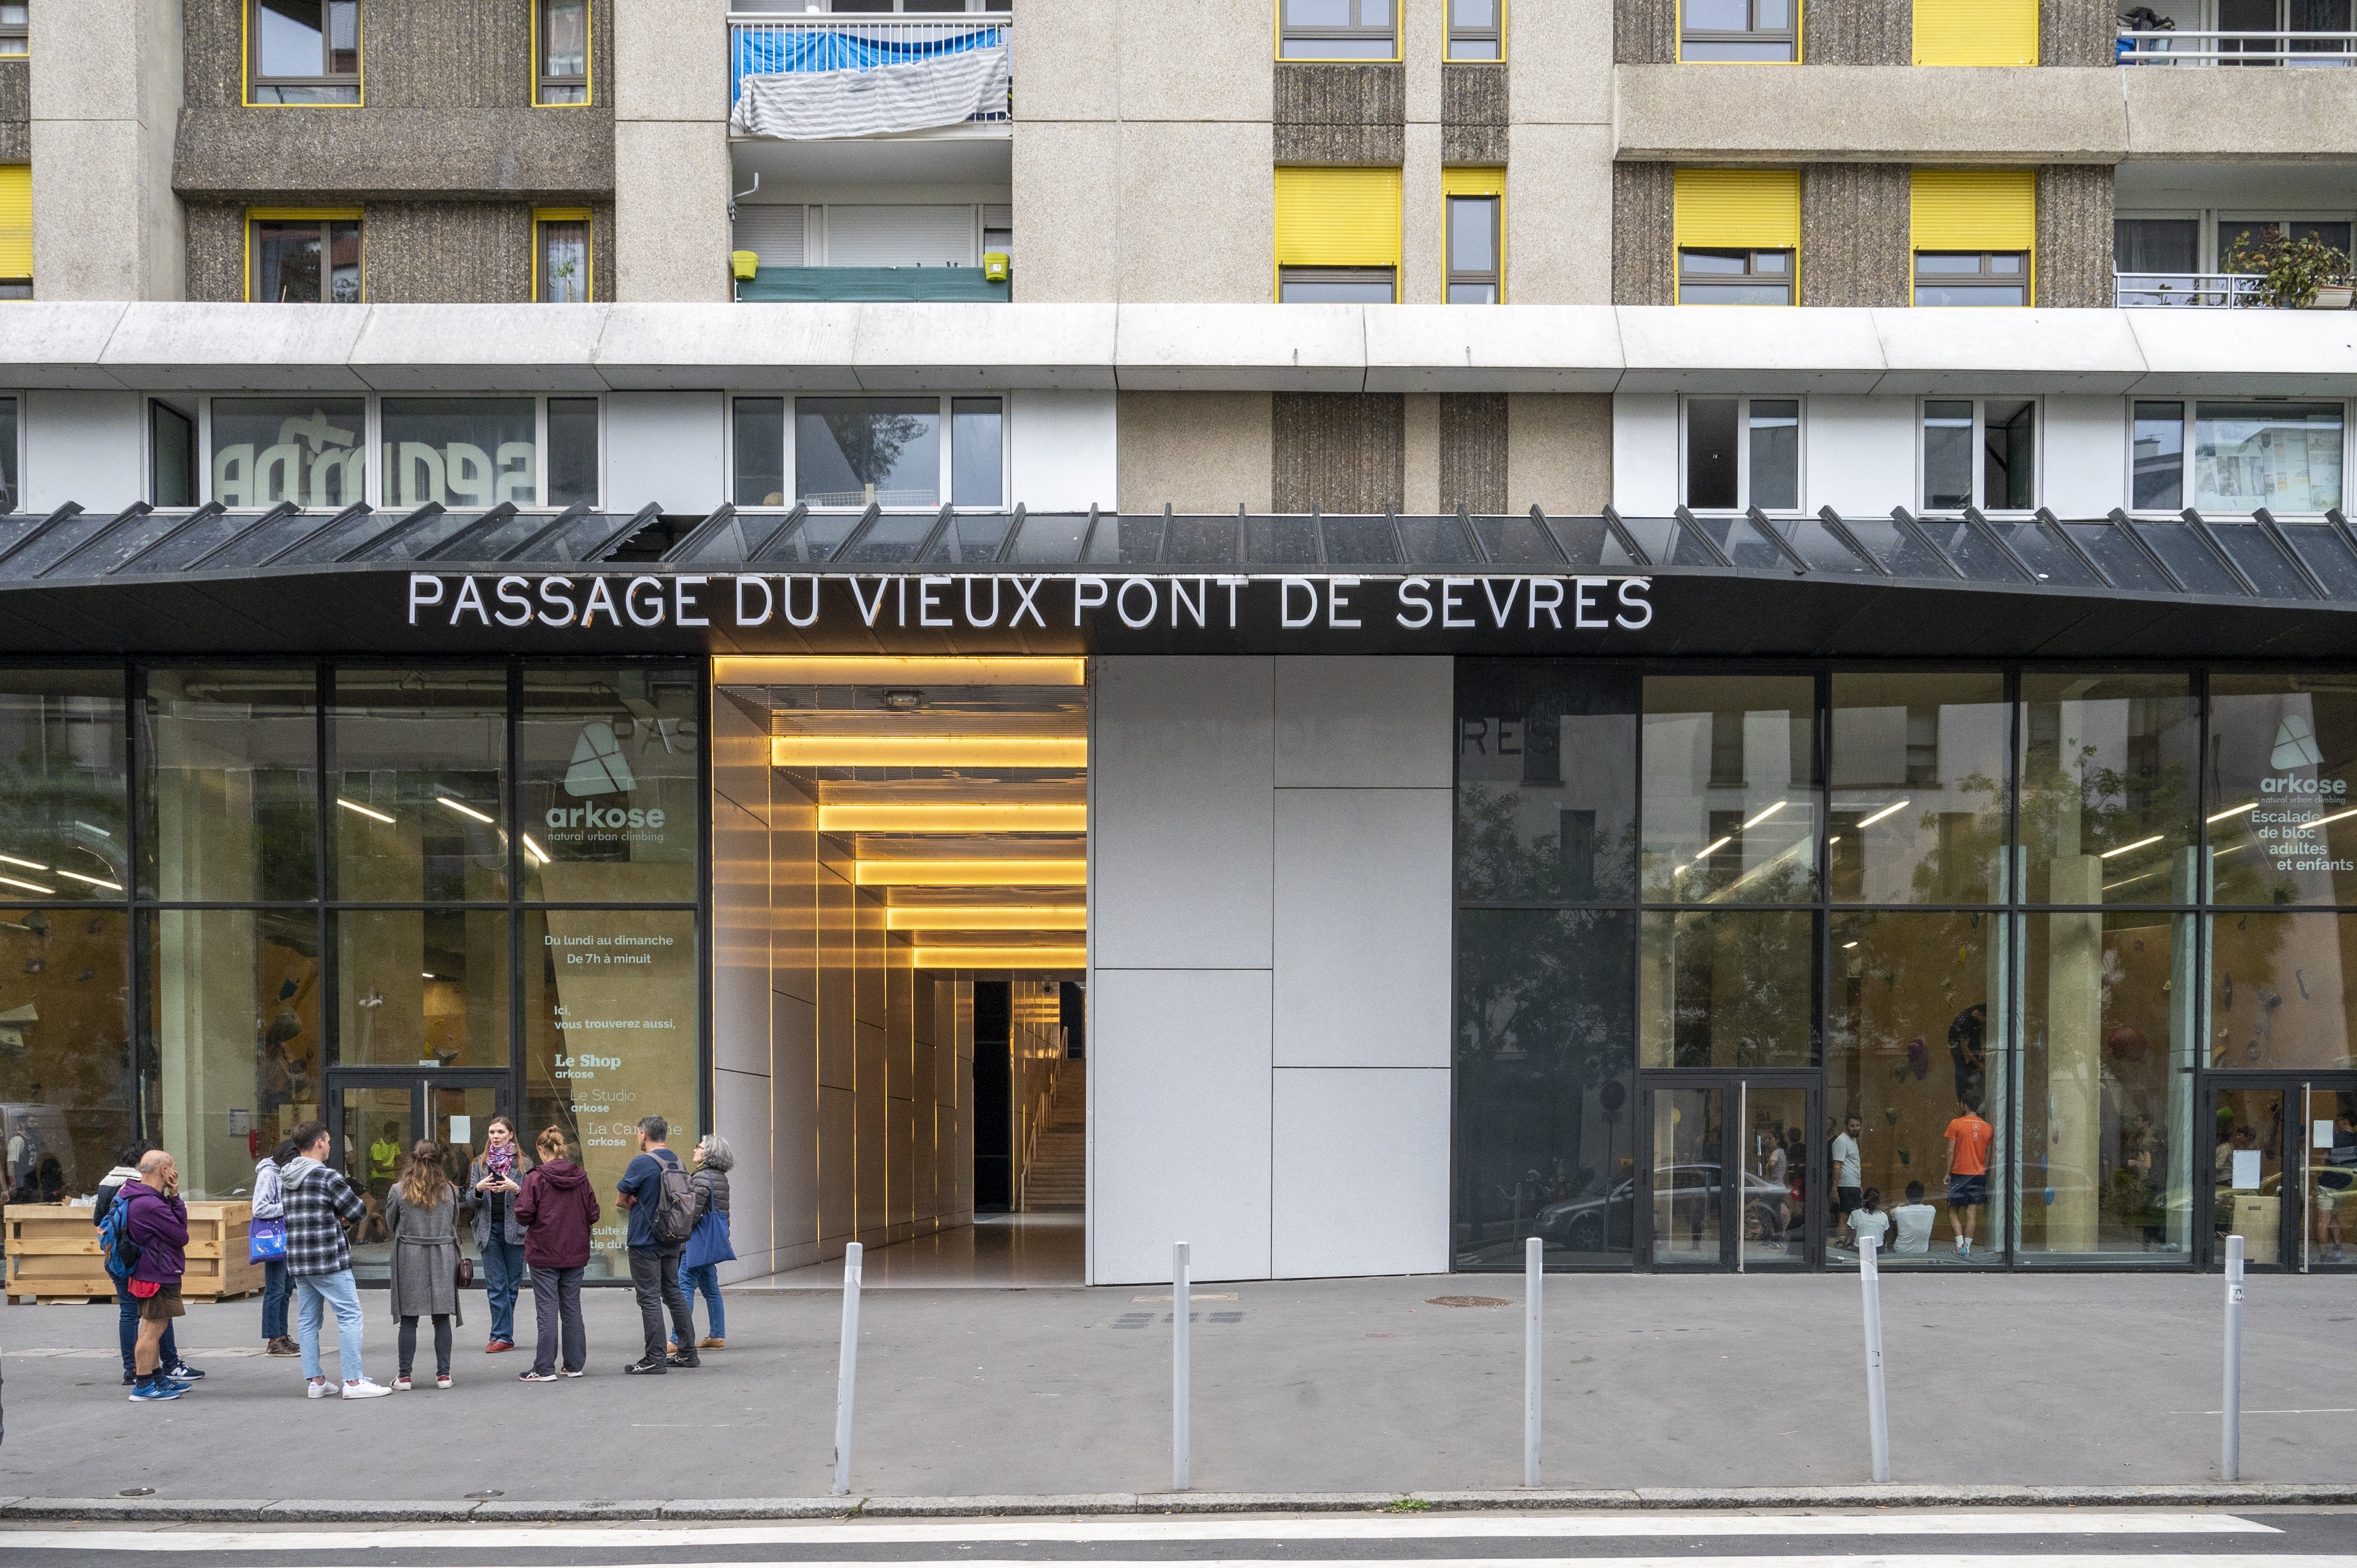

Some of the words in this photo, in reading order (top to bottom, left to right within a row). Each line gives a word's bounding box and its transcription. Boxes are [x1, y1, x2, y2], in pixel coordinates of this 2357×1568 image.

[409, 576, 711, 627] PASSAGE
[736, 577, 819, 627] DU
[849, 577, 1045, 627] VIEUX
[1074, 579, 1248, 628] PONT
[1282, 579, 1362, 628] DE
[1397, 579, 1652, 629] SEVRES
[2260, 773, 2347, 794] arkose
[2315, 796, 2345, 805] climbing
[546, 801, 665, 828] arkose
[2252, 810, 2320, 823] Escalade
[548, 831, 583, 841] natural
[588, 832, 617, 841] urban
[622, 831, 664, 843] climbing
[2259, 826, 2279, 839] de
[2282, 826, 2315, 839] bloc
[2270, 842, 2327, 855] adultes
[2277, 859, 2292, 871] et
[2296, 858, 2354, 871] enfants
[545, 935, 561, 946] Du
[563, 935, 594, 946] lundi
[615, 935, 673, 946] dimanche
[567, 954, 583, 963] De
[585, 954, 601, 963] 7h
[604, 954, 611, 963] à
[614, 953, 651, 963] minuit
[554, 1005, 571, 1017] Ici,
[585, 1020, 640, 1029] trouverez
[643, 1019, 675, 1031] aussi,
[555, 1054, 575, 1067] Le
[580, 1054, 621, 1070] Shop
[555, 1070, 594, 1079] arkose
[571, 1089, 588, 1101] Le
[593, 1089, 636, 1101] Studio
[571, 1103, 609, 1113] arkose
[588, 1123, 607, 1134] La
[588, 1137, 626, 1146] arkose
[592, 1226, 619, 1235] suite
[590, 1240, 604, 1249] tie
[607, 1239, 622, 1249] du
